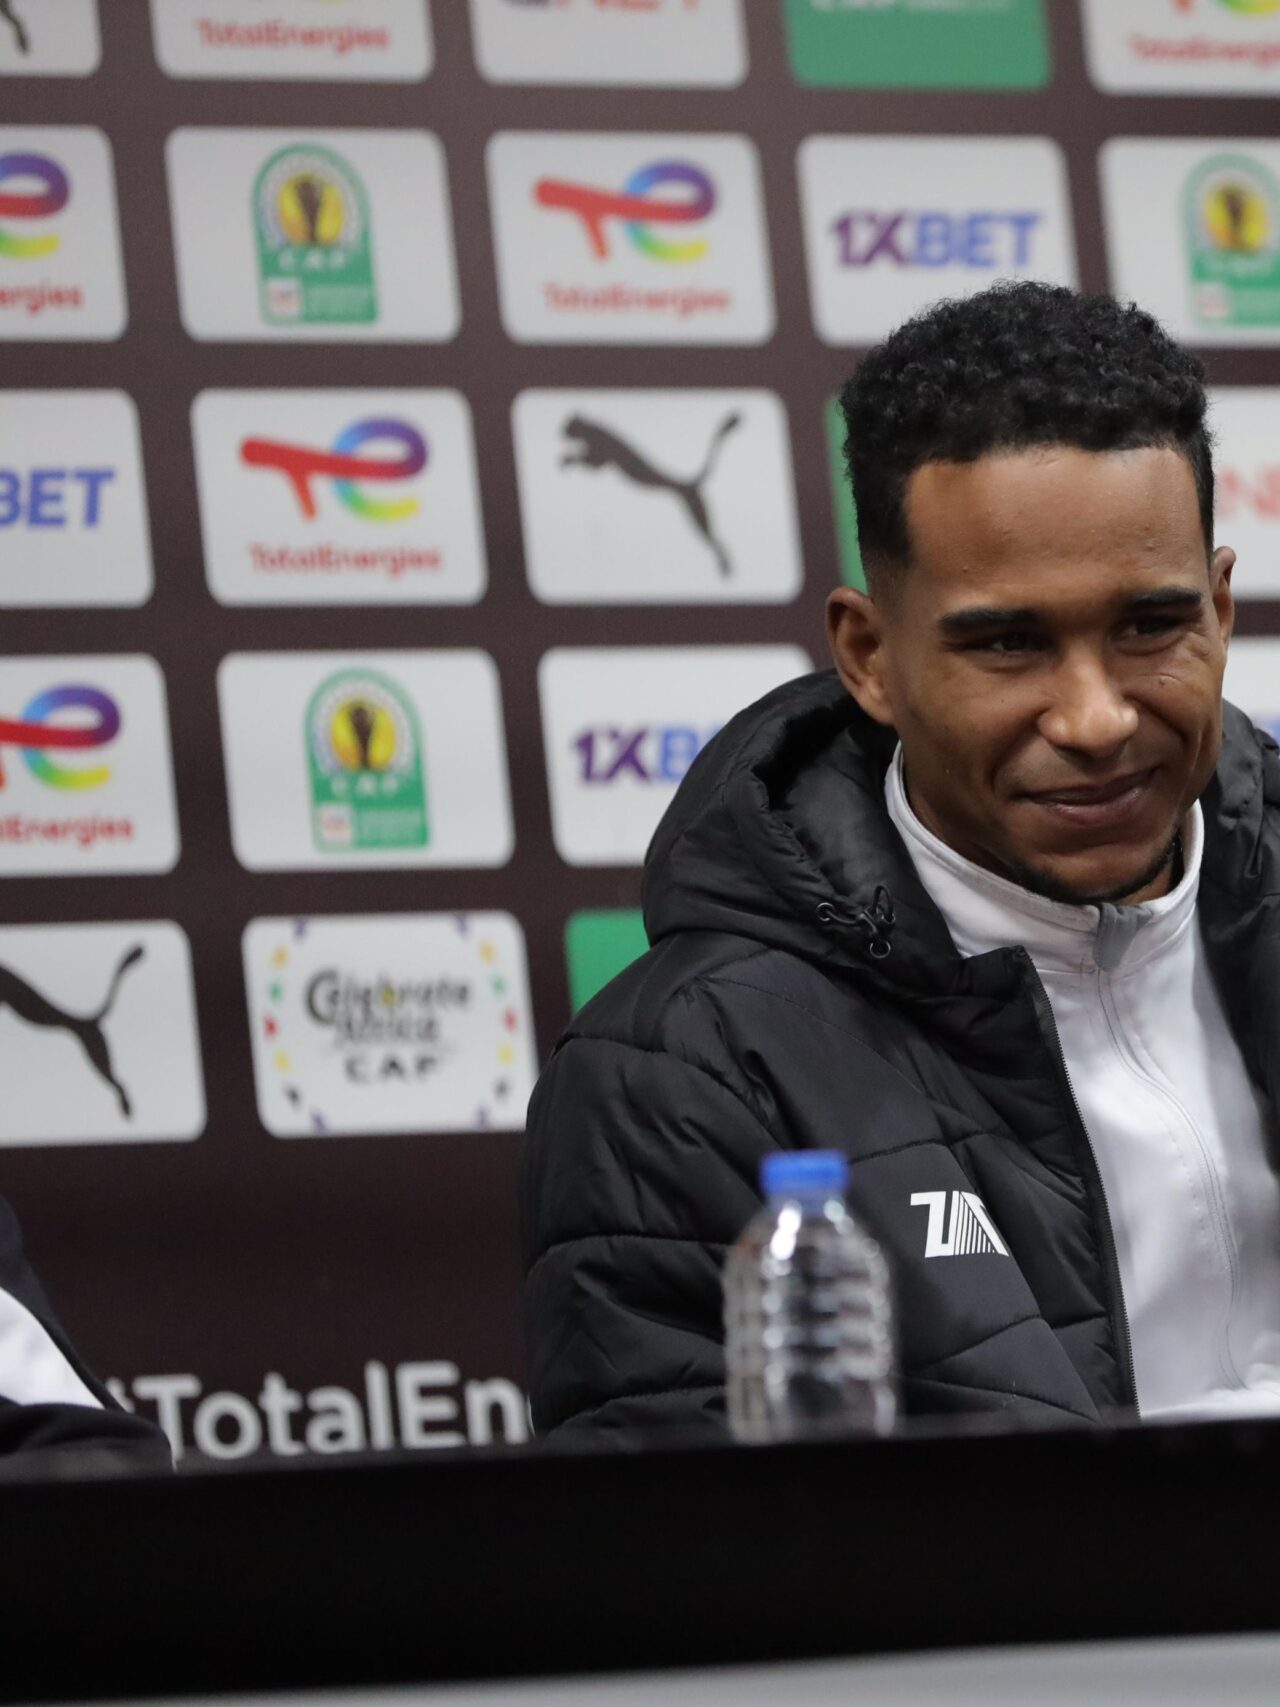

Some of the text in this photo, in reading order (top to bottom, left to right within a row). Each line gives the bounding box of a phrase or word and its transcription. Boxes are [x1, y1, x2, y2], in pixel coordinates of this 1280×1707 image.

[195, 17, 389, 54] TotalEnergies
[829, 210, 1042, 269] 1XBET
[543, 281, 731, 317] TotalEnergies
[248, 542, 443, 577] TotalEnergies
[575, 724, 722, 782] 1XB
[329, 774, 401, 798] CAF
[344, 1053, 440, 1084] CAF
